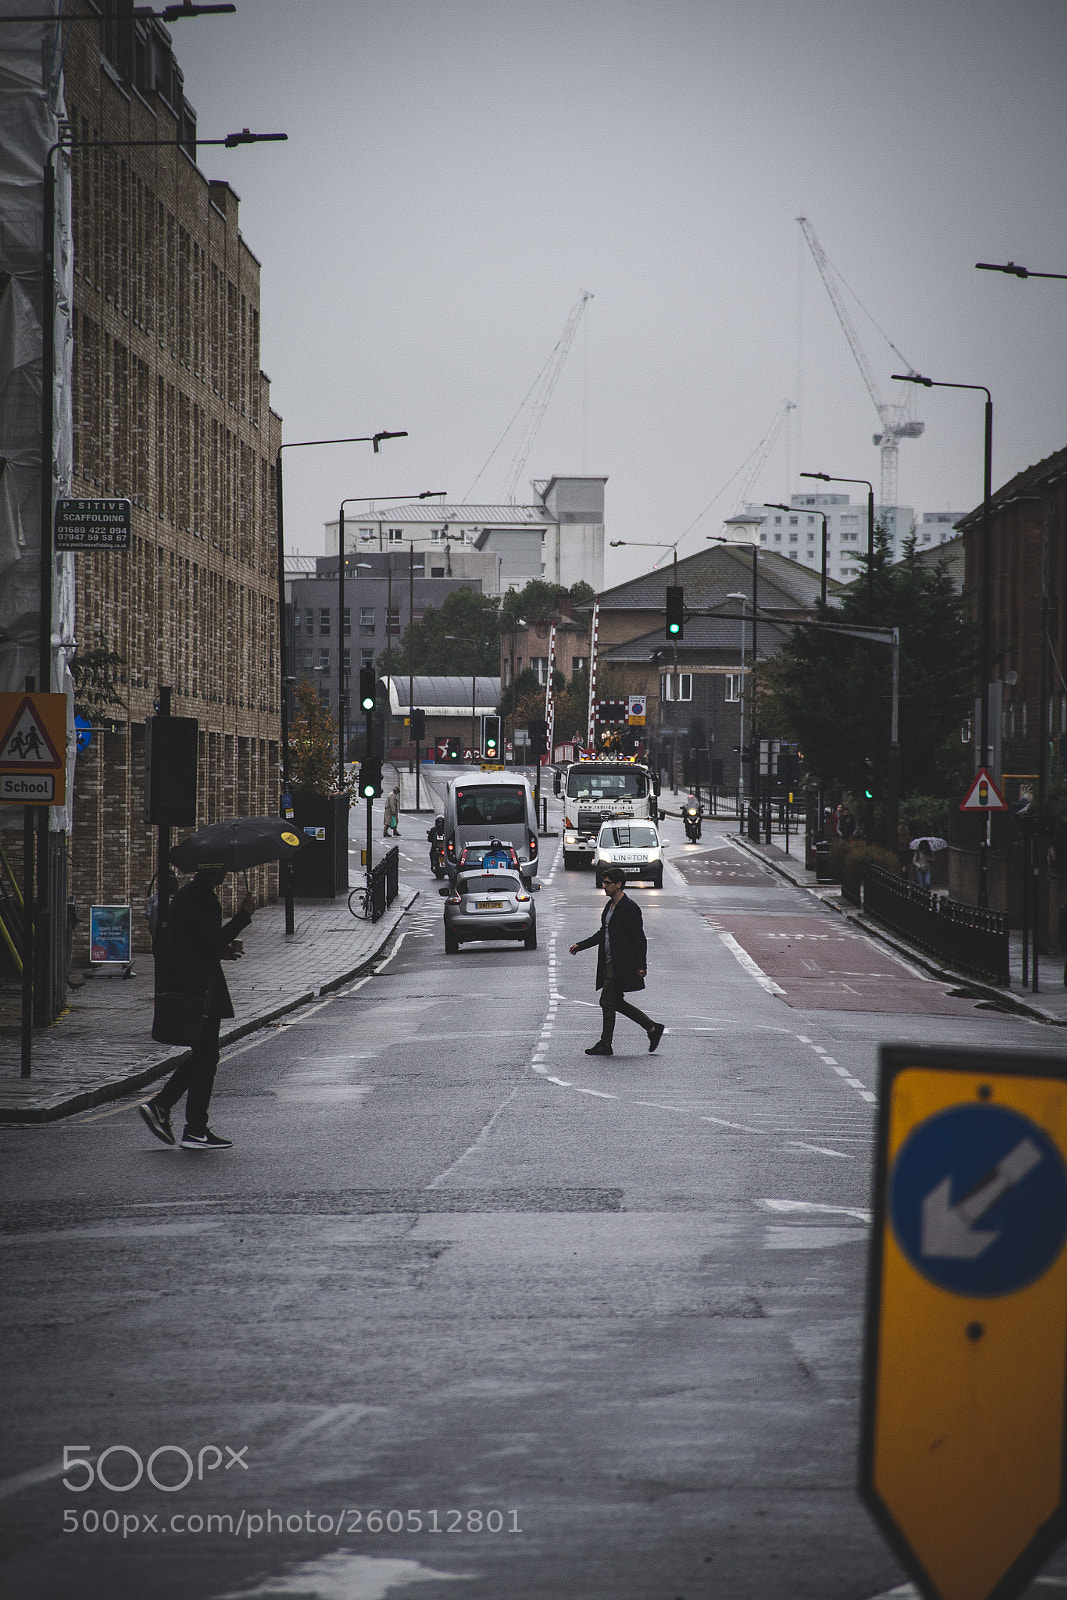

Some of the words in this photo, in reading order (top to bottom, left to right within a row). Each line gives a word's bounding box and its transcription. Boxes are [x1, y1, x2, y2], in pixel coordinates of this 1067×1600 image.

[63, 501, 125, 510] PSITIVE
[62, 513, 125, 522] SCAFFOLDING
[57, 526, 86, 534] 01689
[89, 526, 106, 534] 422
[109, 527, 127, 535] 094
[101, 534, 113, 542] 58
[4, 780, 49, 793] School
